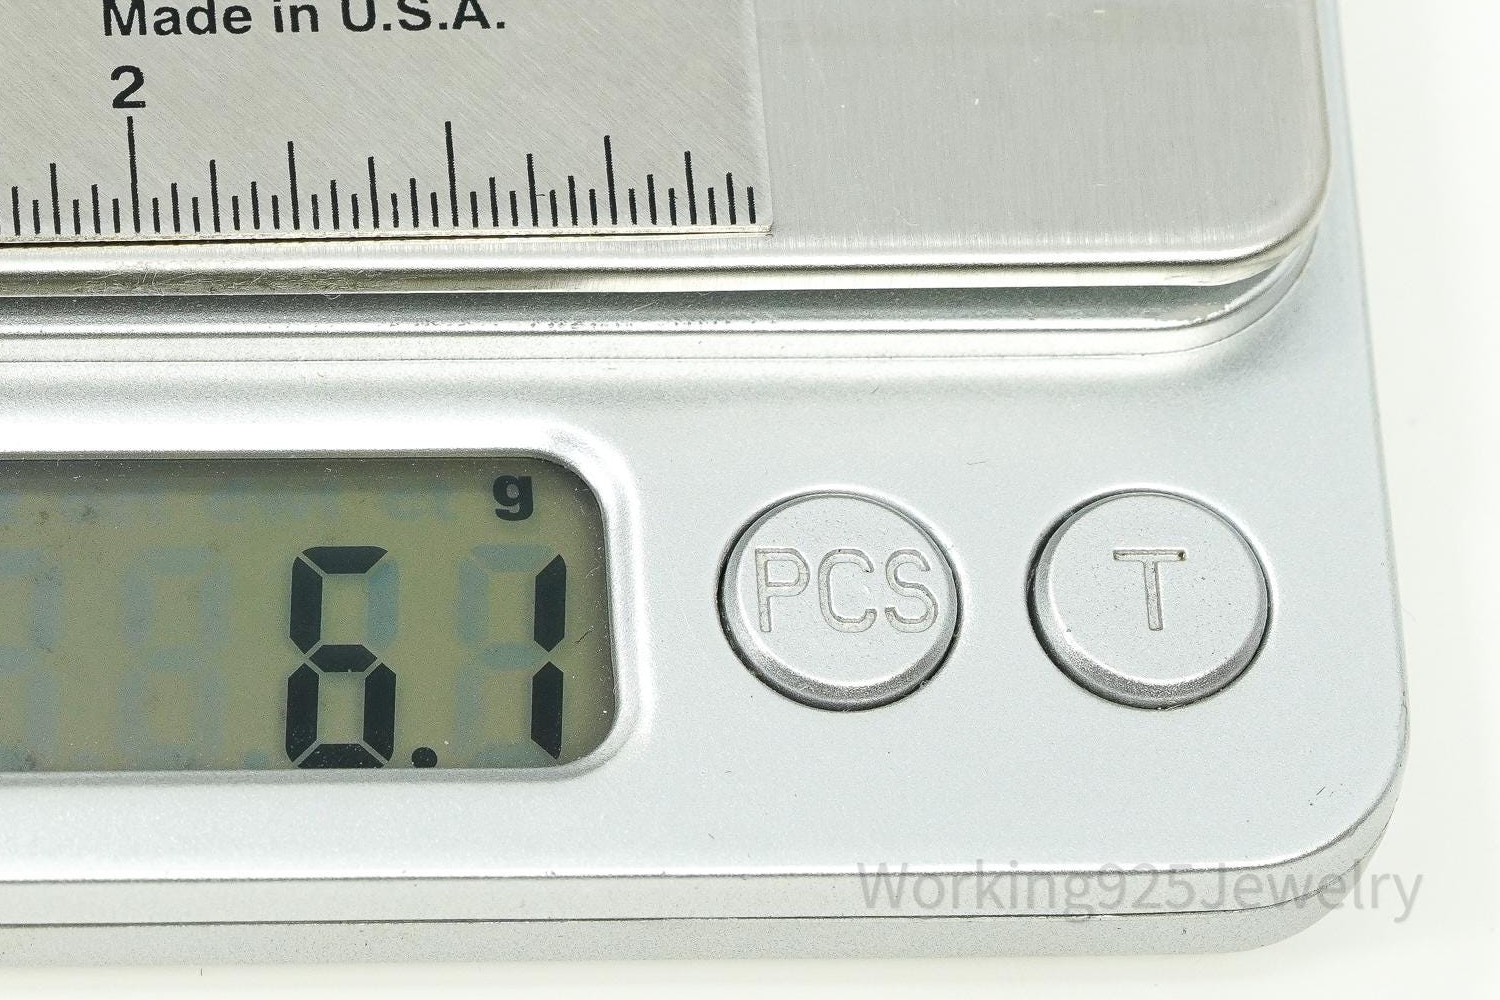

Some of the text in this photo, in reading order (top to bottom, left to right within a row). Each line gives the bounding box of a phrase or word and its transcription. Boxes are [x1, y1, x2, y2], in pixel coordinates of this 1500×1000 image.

[109, 64, 148, 110] 2
[491, 474, 535, 523] g
[754, 547, 940, 635] PCS
[1112, 548, 1187, 632] T
[284, 544, 568, 770] 6.1
